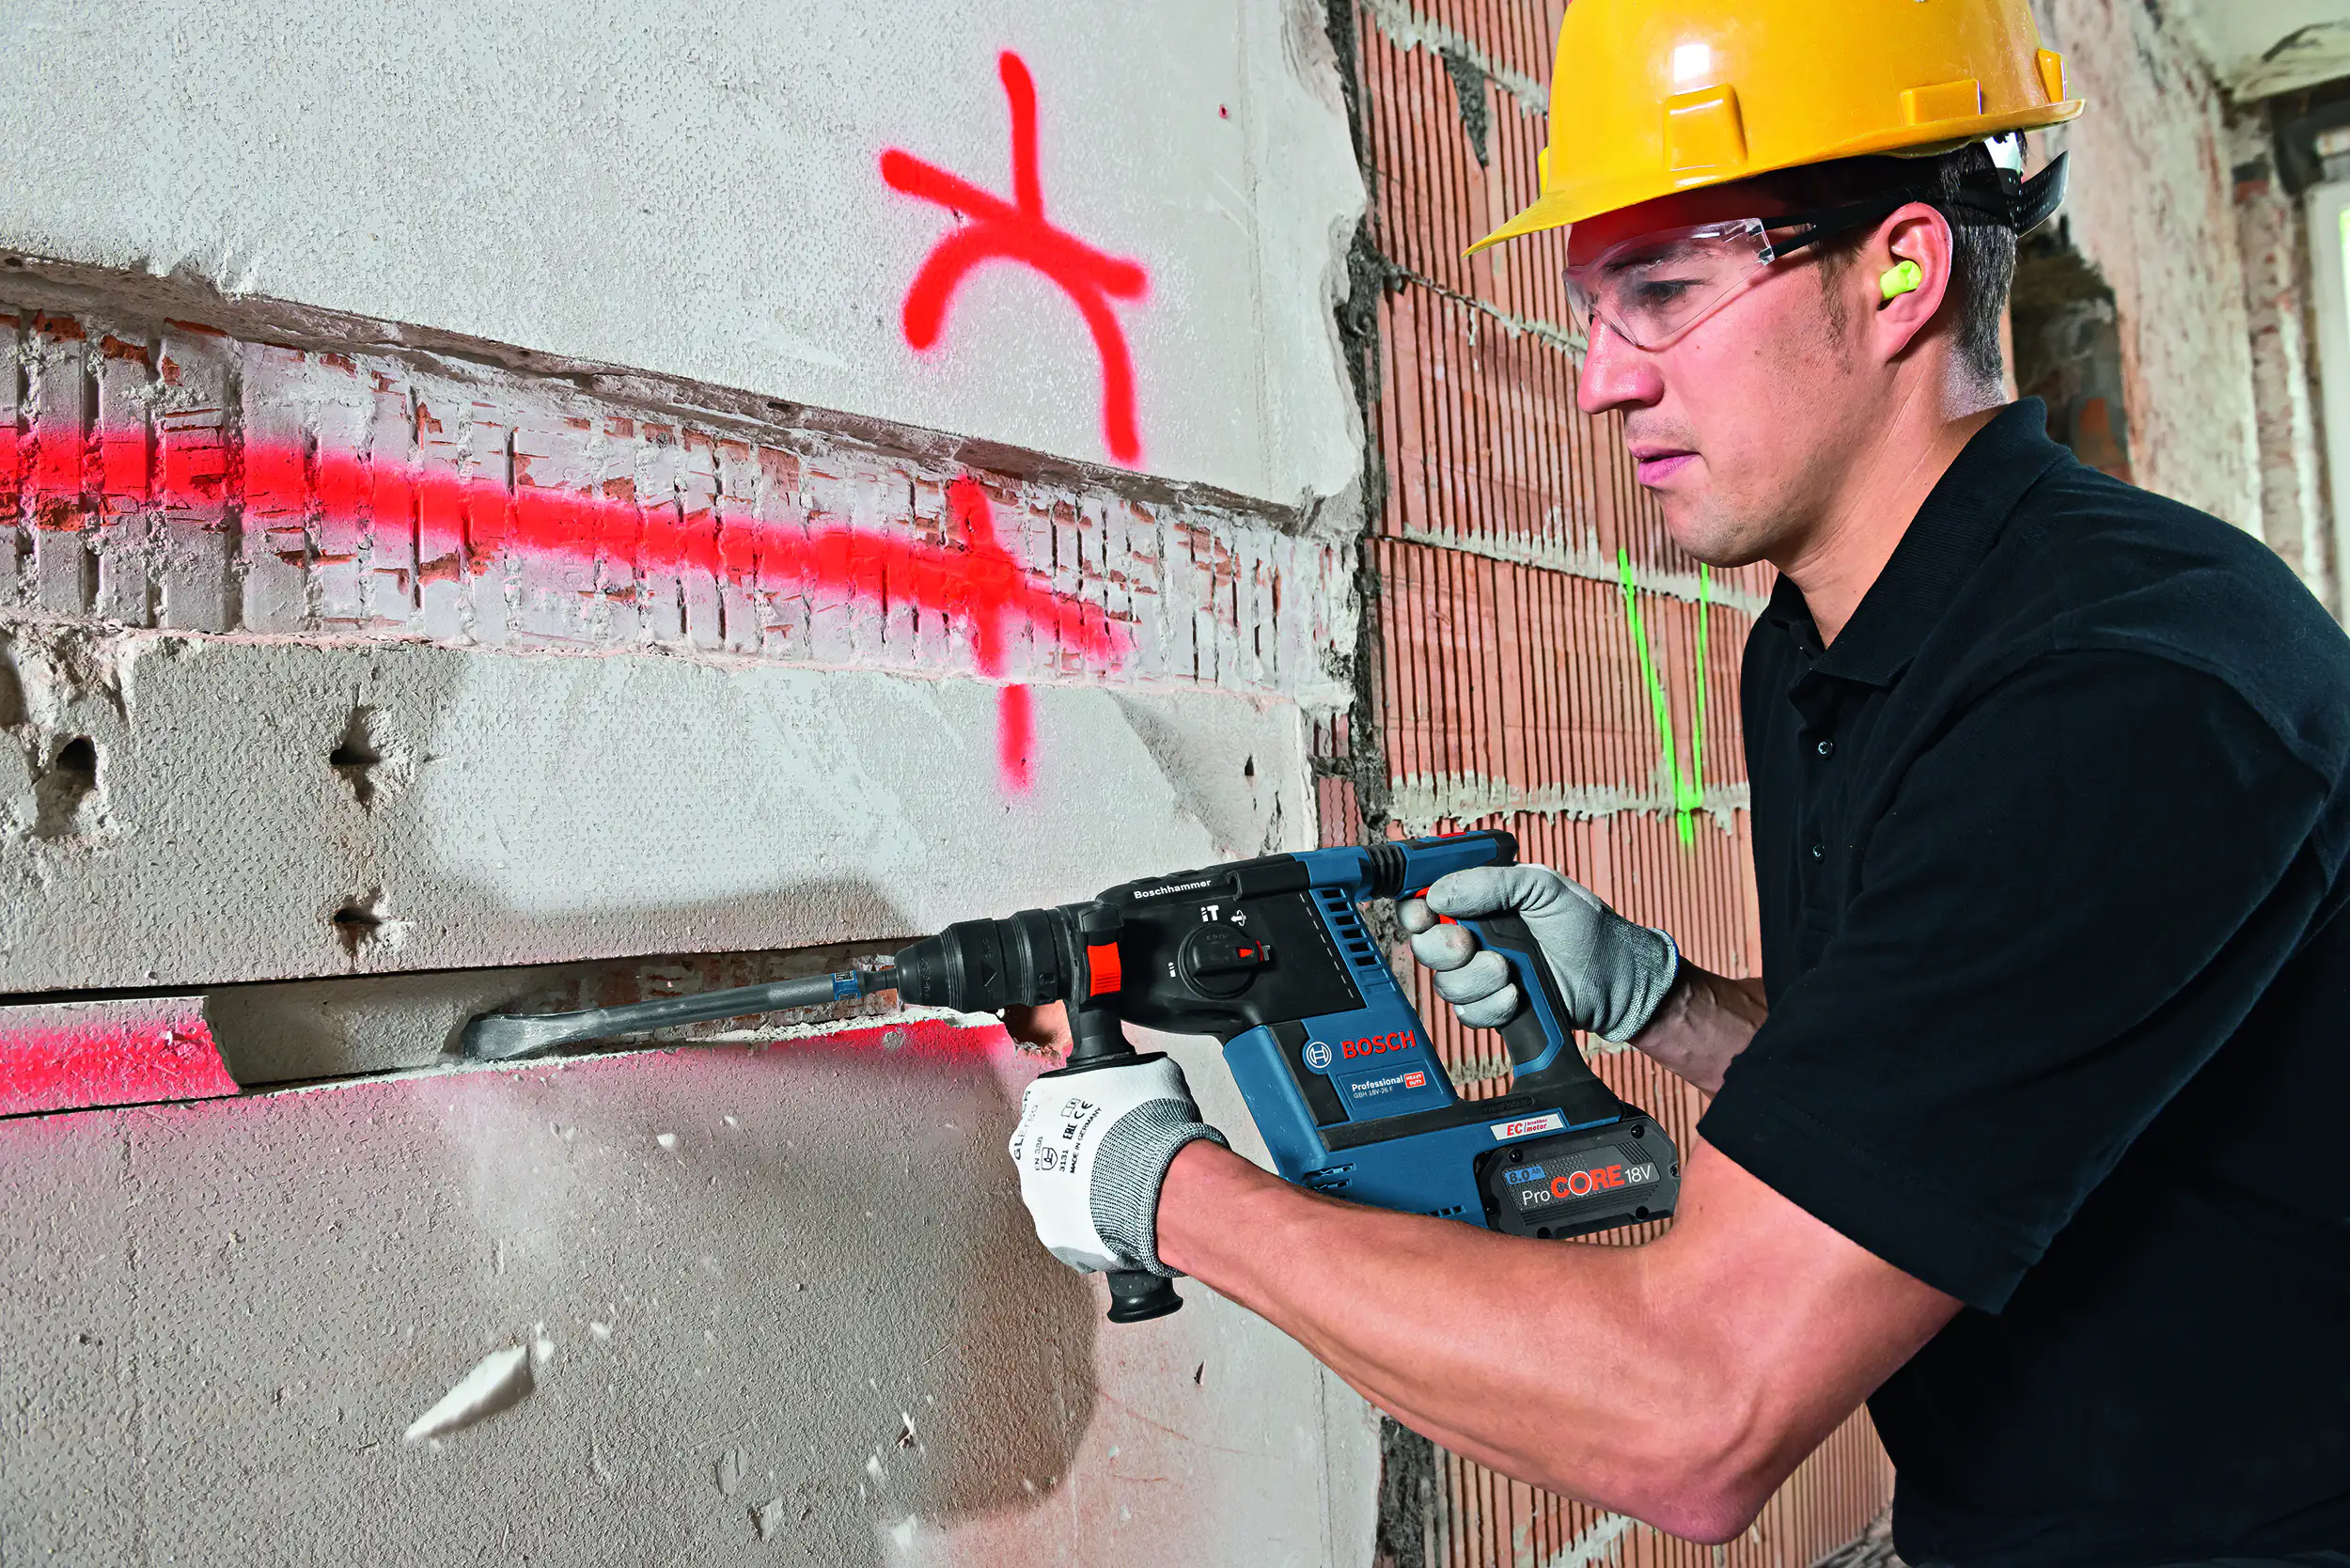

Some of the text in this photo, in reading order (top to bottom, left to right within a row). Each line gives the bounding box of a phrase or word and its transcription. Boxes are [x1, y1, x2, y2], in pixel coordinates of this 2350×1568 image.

[1134, 880, 1212, 899] Boschhammer
[1341, 1029, 1417, 1059] BOSCH
[1352, 1074, 1403, 1091] Professional
[1507, 1123, 1523, 1137] EC
[1527, 1123, 1547, 1132] motor
[1070, 1152, 1079, 1173] MADE
[1077, 1106, 1102, 1140] GERMANY
[1509, 1168, 1542, 1184] 8.0 Ah
